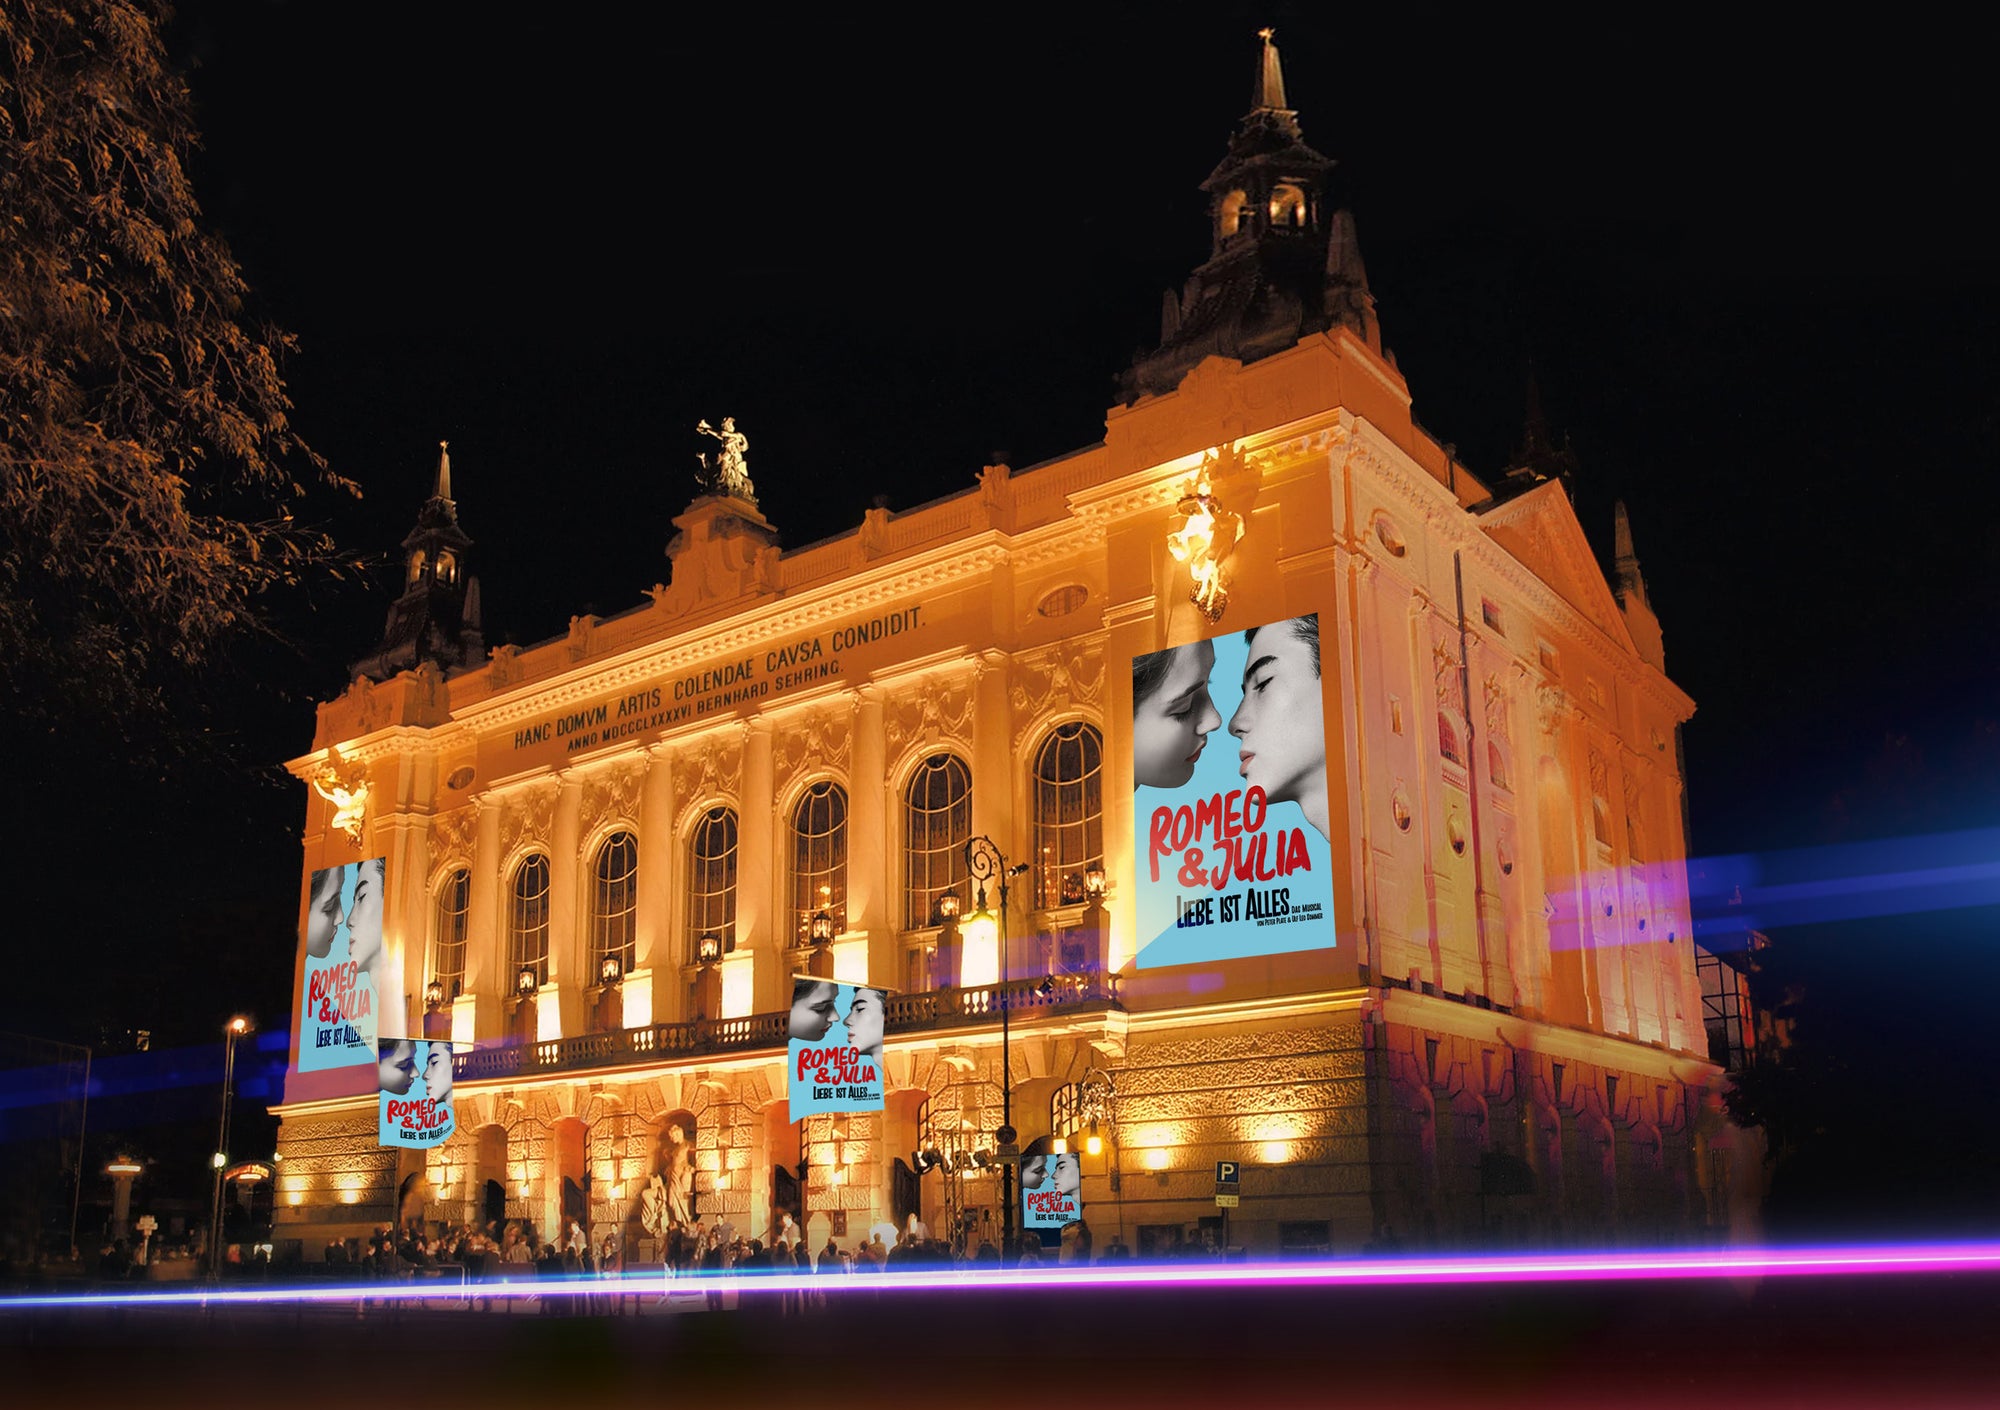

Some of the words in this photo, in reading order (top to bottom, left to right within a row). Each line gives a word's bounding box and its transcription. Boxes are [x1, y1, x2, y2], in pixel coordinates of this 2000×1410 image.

[515, 723, 551, 749] HANC
[557, 705, 607, 736] DOMVM
[618, 688, 661, 718] ARTIS
[674, 658, 754, 700] COLENDAE
[766, 639, 822, 673] CAVSA
[832, 606, 926, 652] CONDIDIT.
[567, 732, 597, 752] ANNO
[602, 704, 691, 741] MDCCCLXXXXVI
[697, 681, 768, 714] BERNHARD
[775, 660, 845, 690] SEHRING.
[1149, 785, 1267, 882] ROMEO
[1211, 827, 1311, 890] JULIA
[308, 960, 358, 1018] ROMEO
[332, 988, 371, 1025] JULIA
[797, 1046, 859, 1082] ROMEO
[831, 1065, 876, 1085] JULIA
[387, 1098, 436, 1124] ROMEO
[415, 1109, 449, 1131] JULIA
[1221, 1163, 1235, 1180] P
[1027, 1191, 1062, 1210] ROMEO
